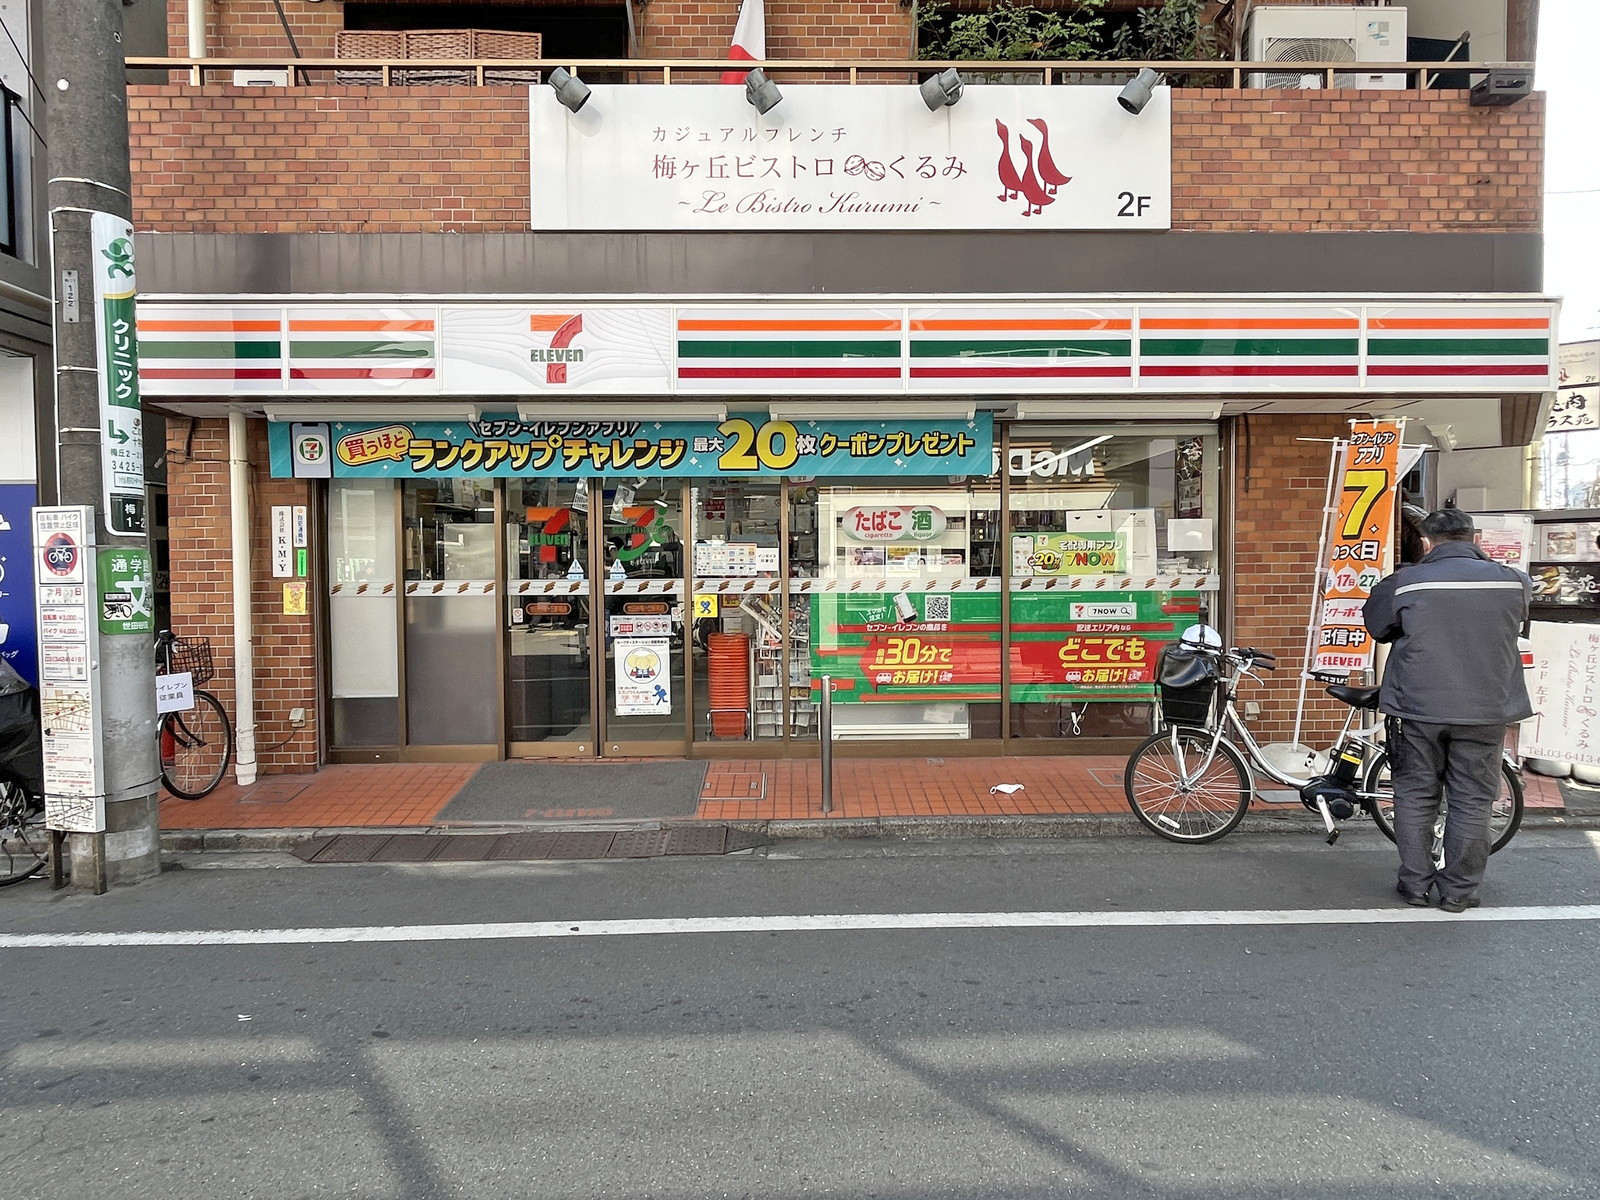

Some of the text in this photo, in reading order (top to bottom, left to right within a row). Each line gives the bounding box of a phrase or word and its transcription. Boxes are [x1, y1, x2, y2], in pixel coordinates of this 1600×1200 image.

[650, 125, 848, 144] カジュアルフレンチ
[651, 154, 968, 181] 梅ヶ丘ビストロ くるみ
[739, 190, 813, 215] Bistro
[1117, 191, 1152, 218] 2F
[111, 317, 133, 400] クリニック
[1552, 391, 1588, 413] 肉
[344, 430, 407, 461] 買うほど
[408, 434, 686, 470] ランクアップチャレンジ
[820, 432, 975, 456] クーポンプレゼント
[1353, 445, 1386, 465] アプリ
[111, 460, 143, 473] 3425-
[1342, 469, 1388, 539] 7
[61, 513, 78, 521] バイク
[855, 510, 933, 531] たばこ 酒
[1066, 551, 1117, 567] 7NOW
[1336, 574, 1356, 587] 17日
[1058, 637, 1146, 661] どこでも
[156, 682, 188, 691] イレブン
[892, 671, 938, 685] お届け!
[1081, 669, 1128, 683] お届け!
